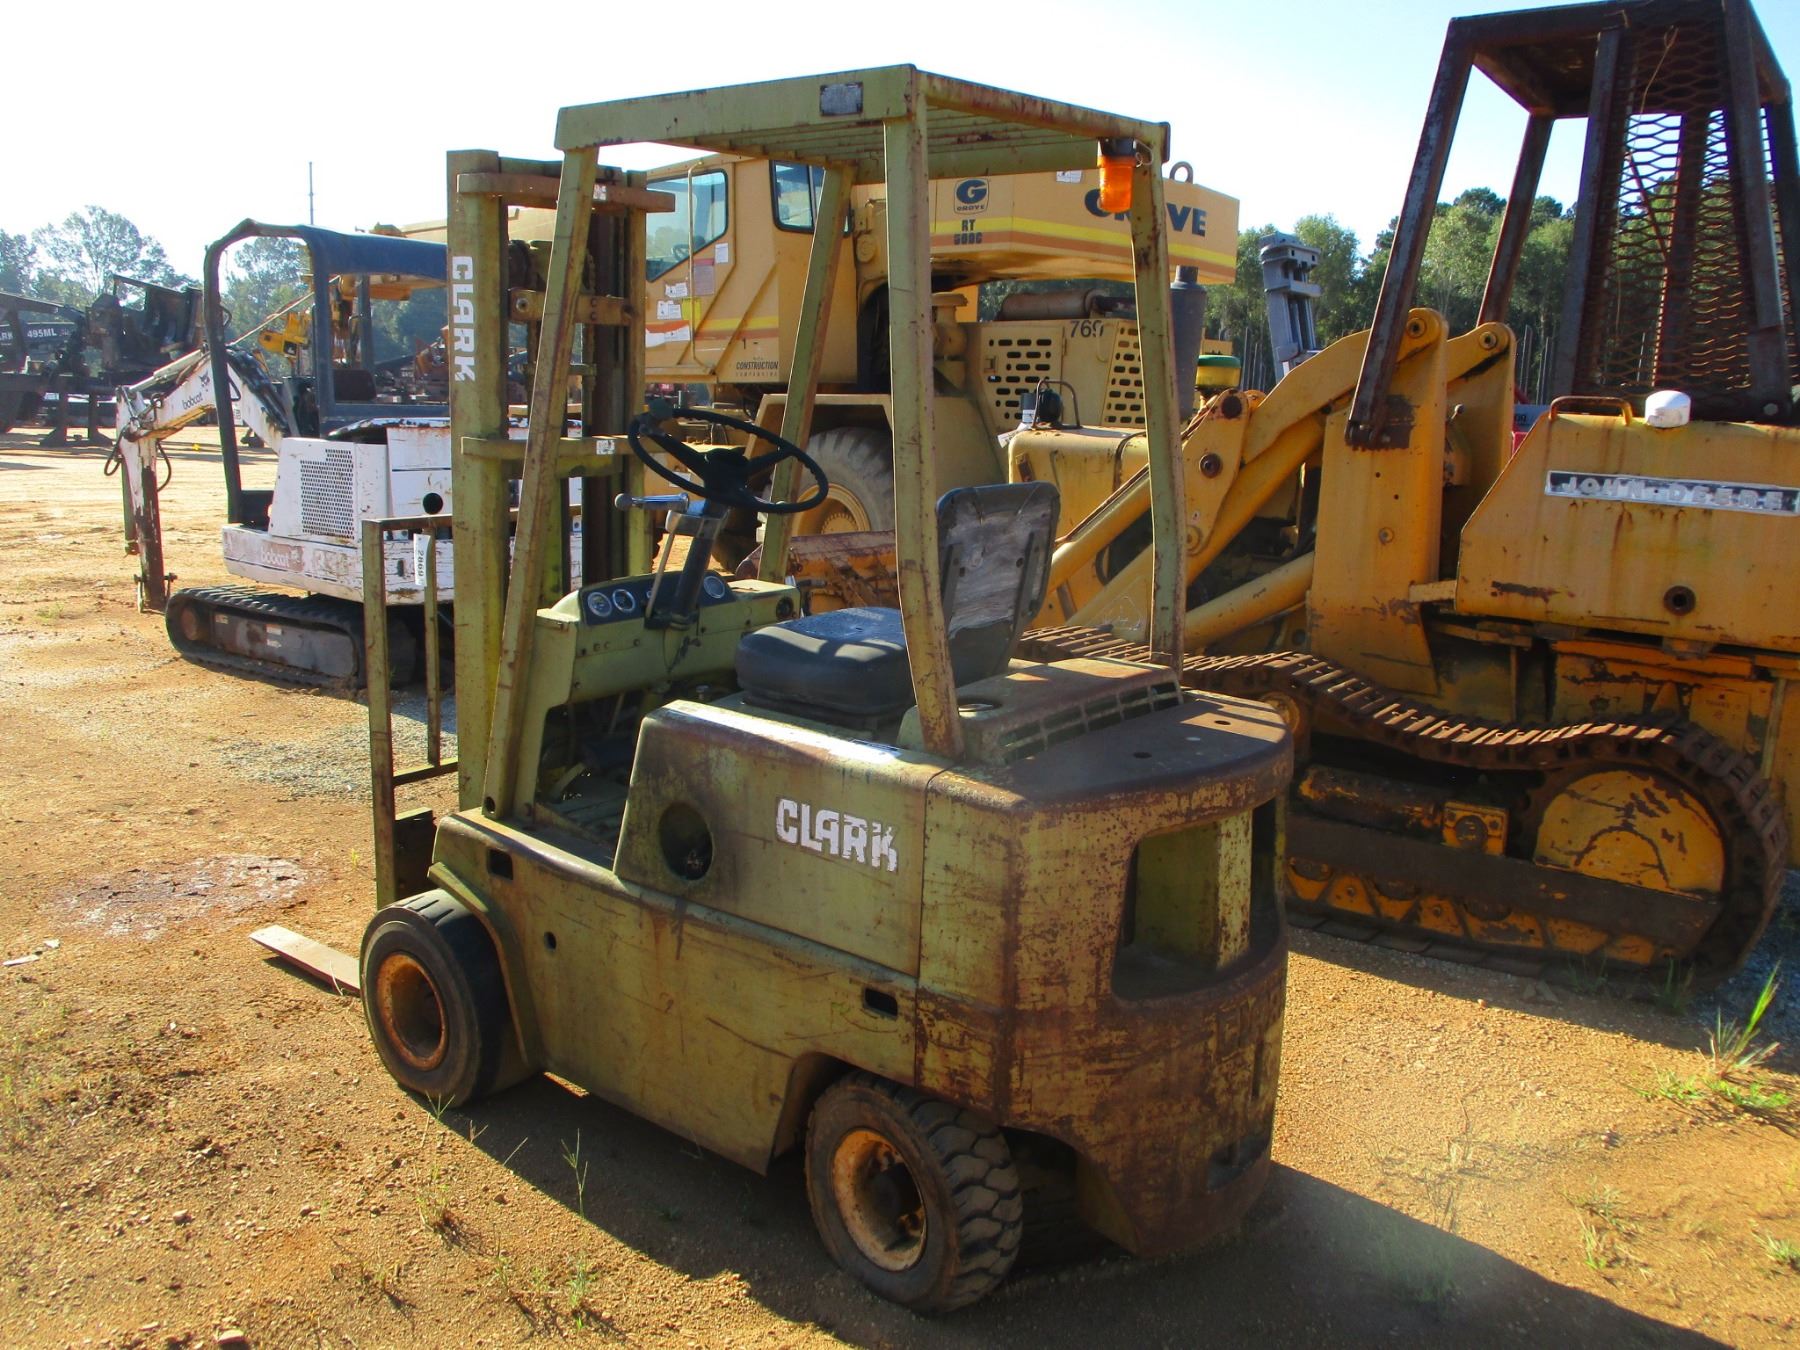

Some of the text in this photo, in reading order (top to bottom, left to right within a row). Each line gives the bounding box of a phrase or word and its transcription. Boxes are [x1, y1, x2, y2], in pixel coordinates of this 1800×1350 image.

[962, 219, 976, 231] RT
[452, 256, 476, 382] CLARK
[27, 328, 57, 338] 495ML
[736, 361, 779, 370] CONSTRUCTION
[181, 392, 204, 410] bobcat
[776, 798, 897, 872] CLARK
